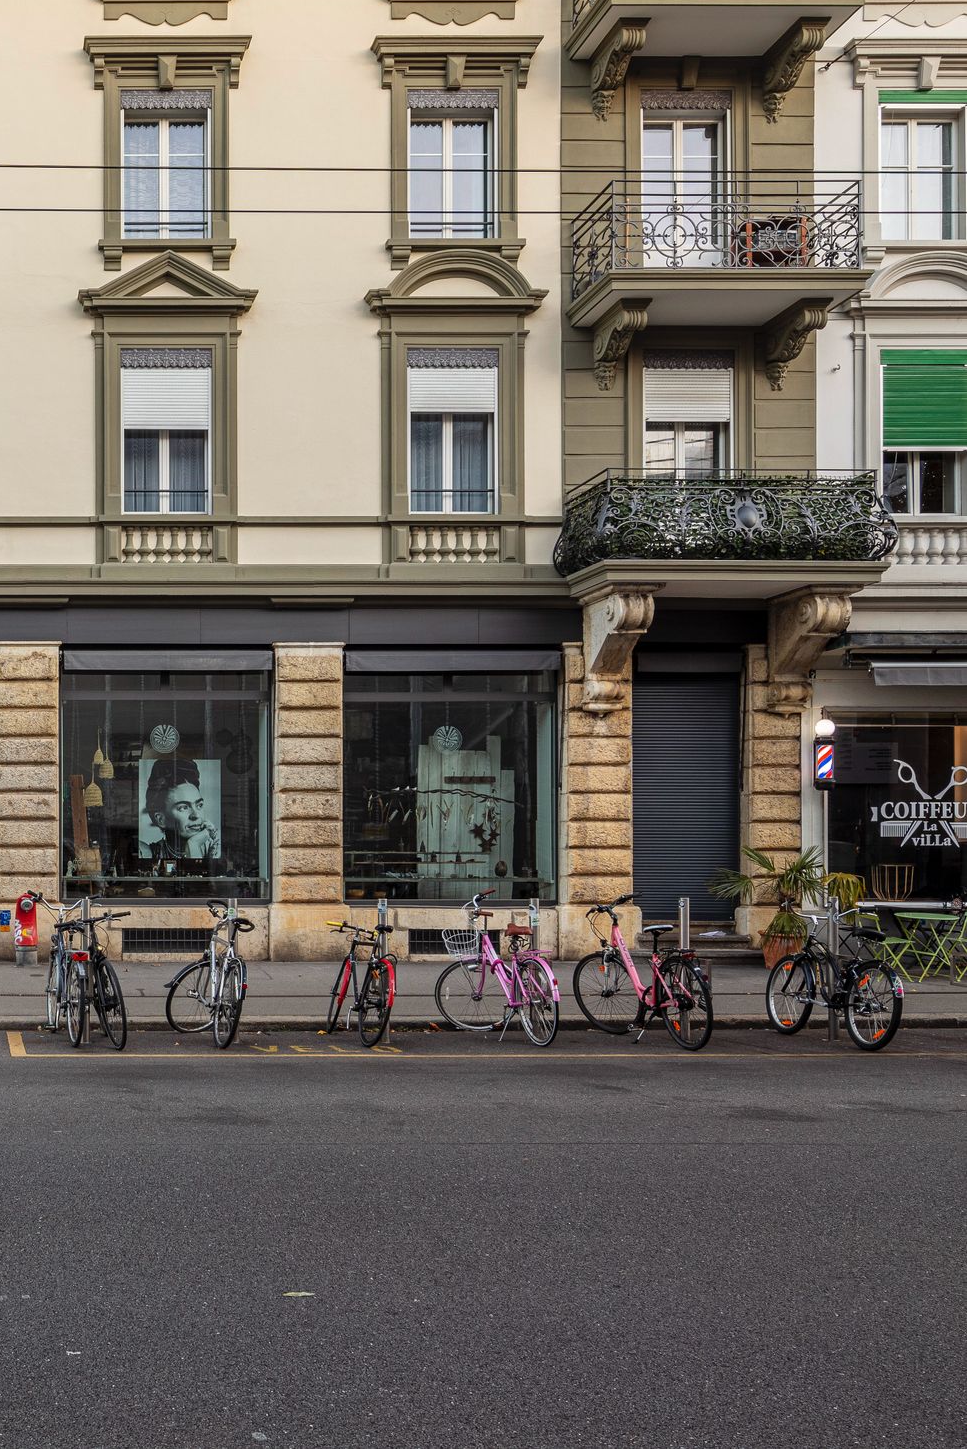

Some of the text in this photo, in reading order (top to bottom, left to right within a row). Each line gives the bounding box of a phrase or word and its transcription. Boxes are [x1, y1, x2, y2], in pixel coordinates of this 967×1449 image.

[880, 801, 967, 819] COIFFEU
[923, 820, 938, 832] La
[911, 833, 952, 847] viLLa
